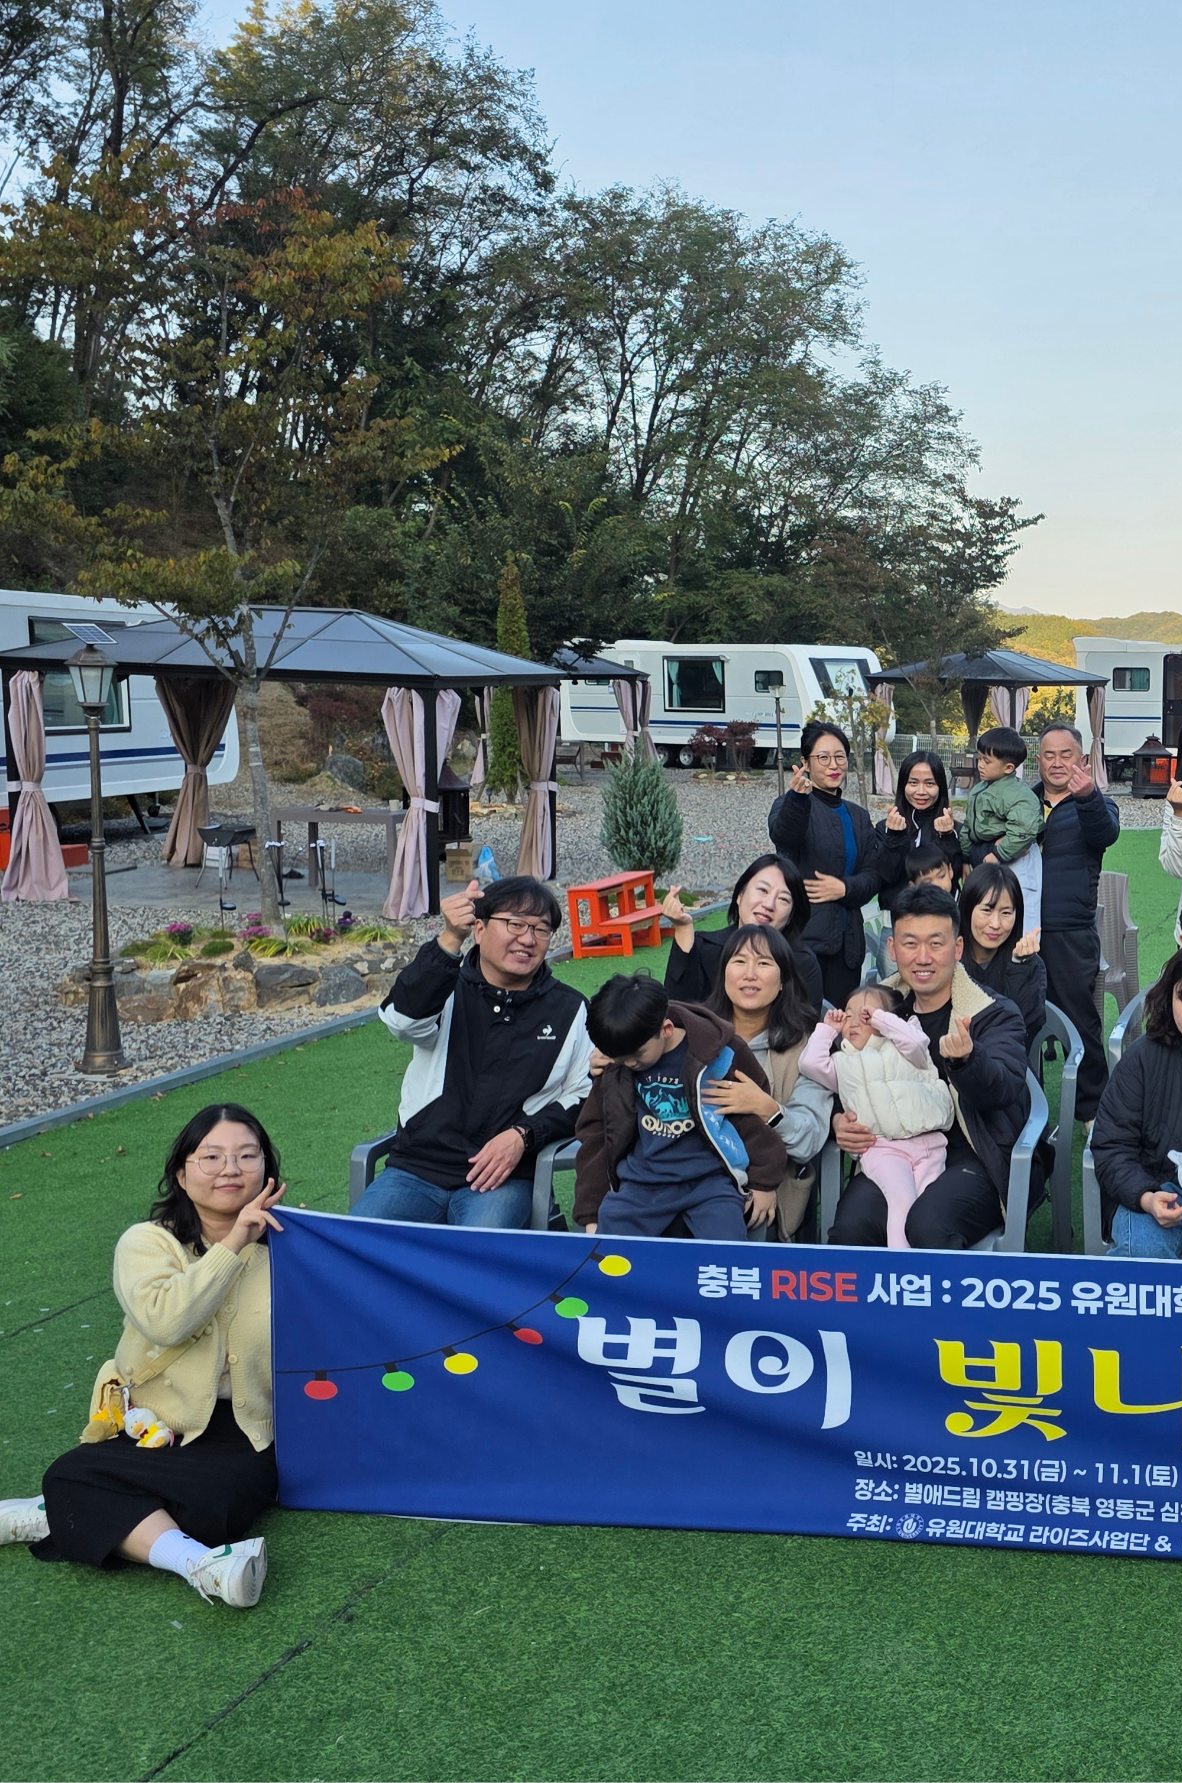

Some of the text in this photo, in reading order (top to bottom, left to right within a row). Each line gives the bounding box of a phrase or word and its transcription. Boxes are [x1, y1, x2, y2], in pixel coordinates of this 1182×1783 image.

[698, 1264, 762, 1300] 충북
[772, 1270, 857, 1301] RISE
[867, 1273, 932, 1307] 사업
[960, 1277, 1062, 1311] 2025
[574, 1314, 852, 1430] 별이
[854, 1450, 897, 1470] 일시:
[902, 1454, 1067, 1483] 2025.10.31(금)
[1095, 1462, 1178, 1488] 11.1(토)
[854, 1478, 900, 1502] 장소:
[904, 1482, 981, 1509] 별애드림
[986, 1489, 1091, 1518] 캠핑장(충북
[1095, 1498, 1155, 1522] 영동군
[846, 1512, 894, 1533] 주최:
[925, 1518, 1026, 1543] 유원대학교
[1028, 1525, 1151, 1552] 라이즈사업단
[1154, 1535, 1172, 1552] &
